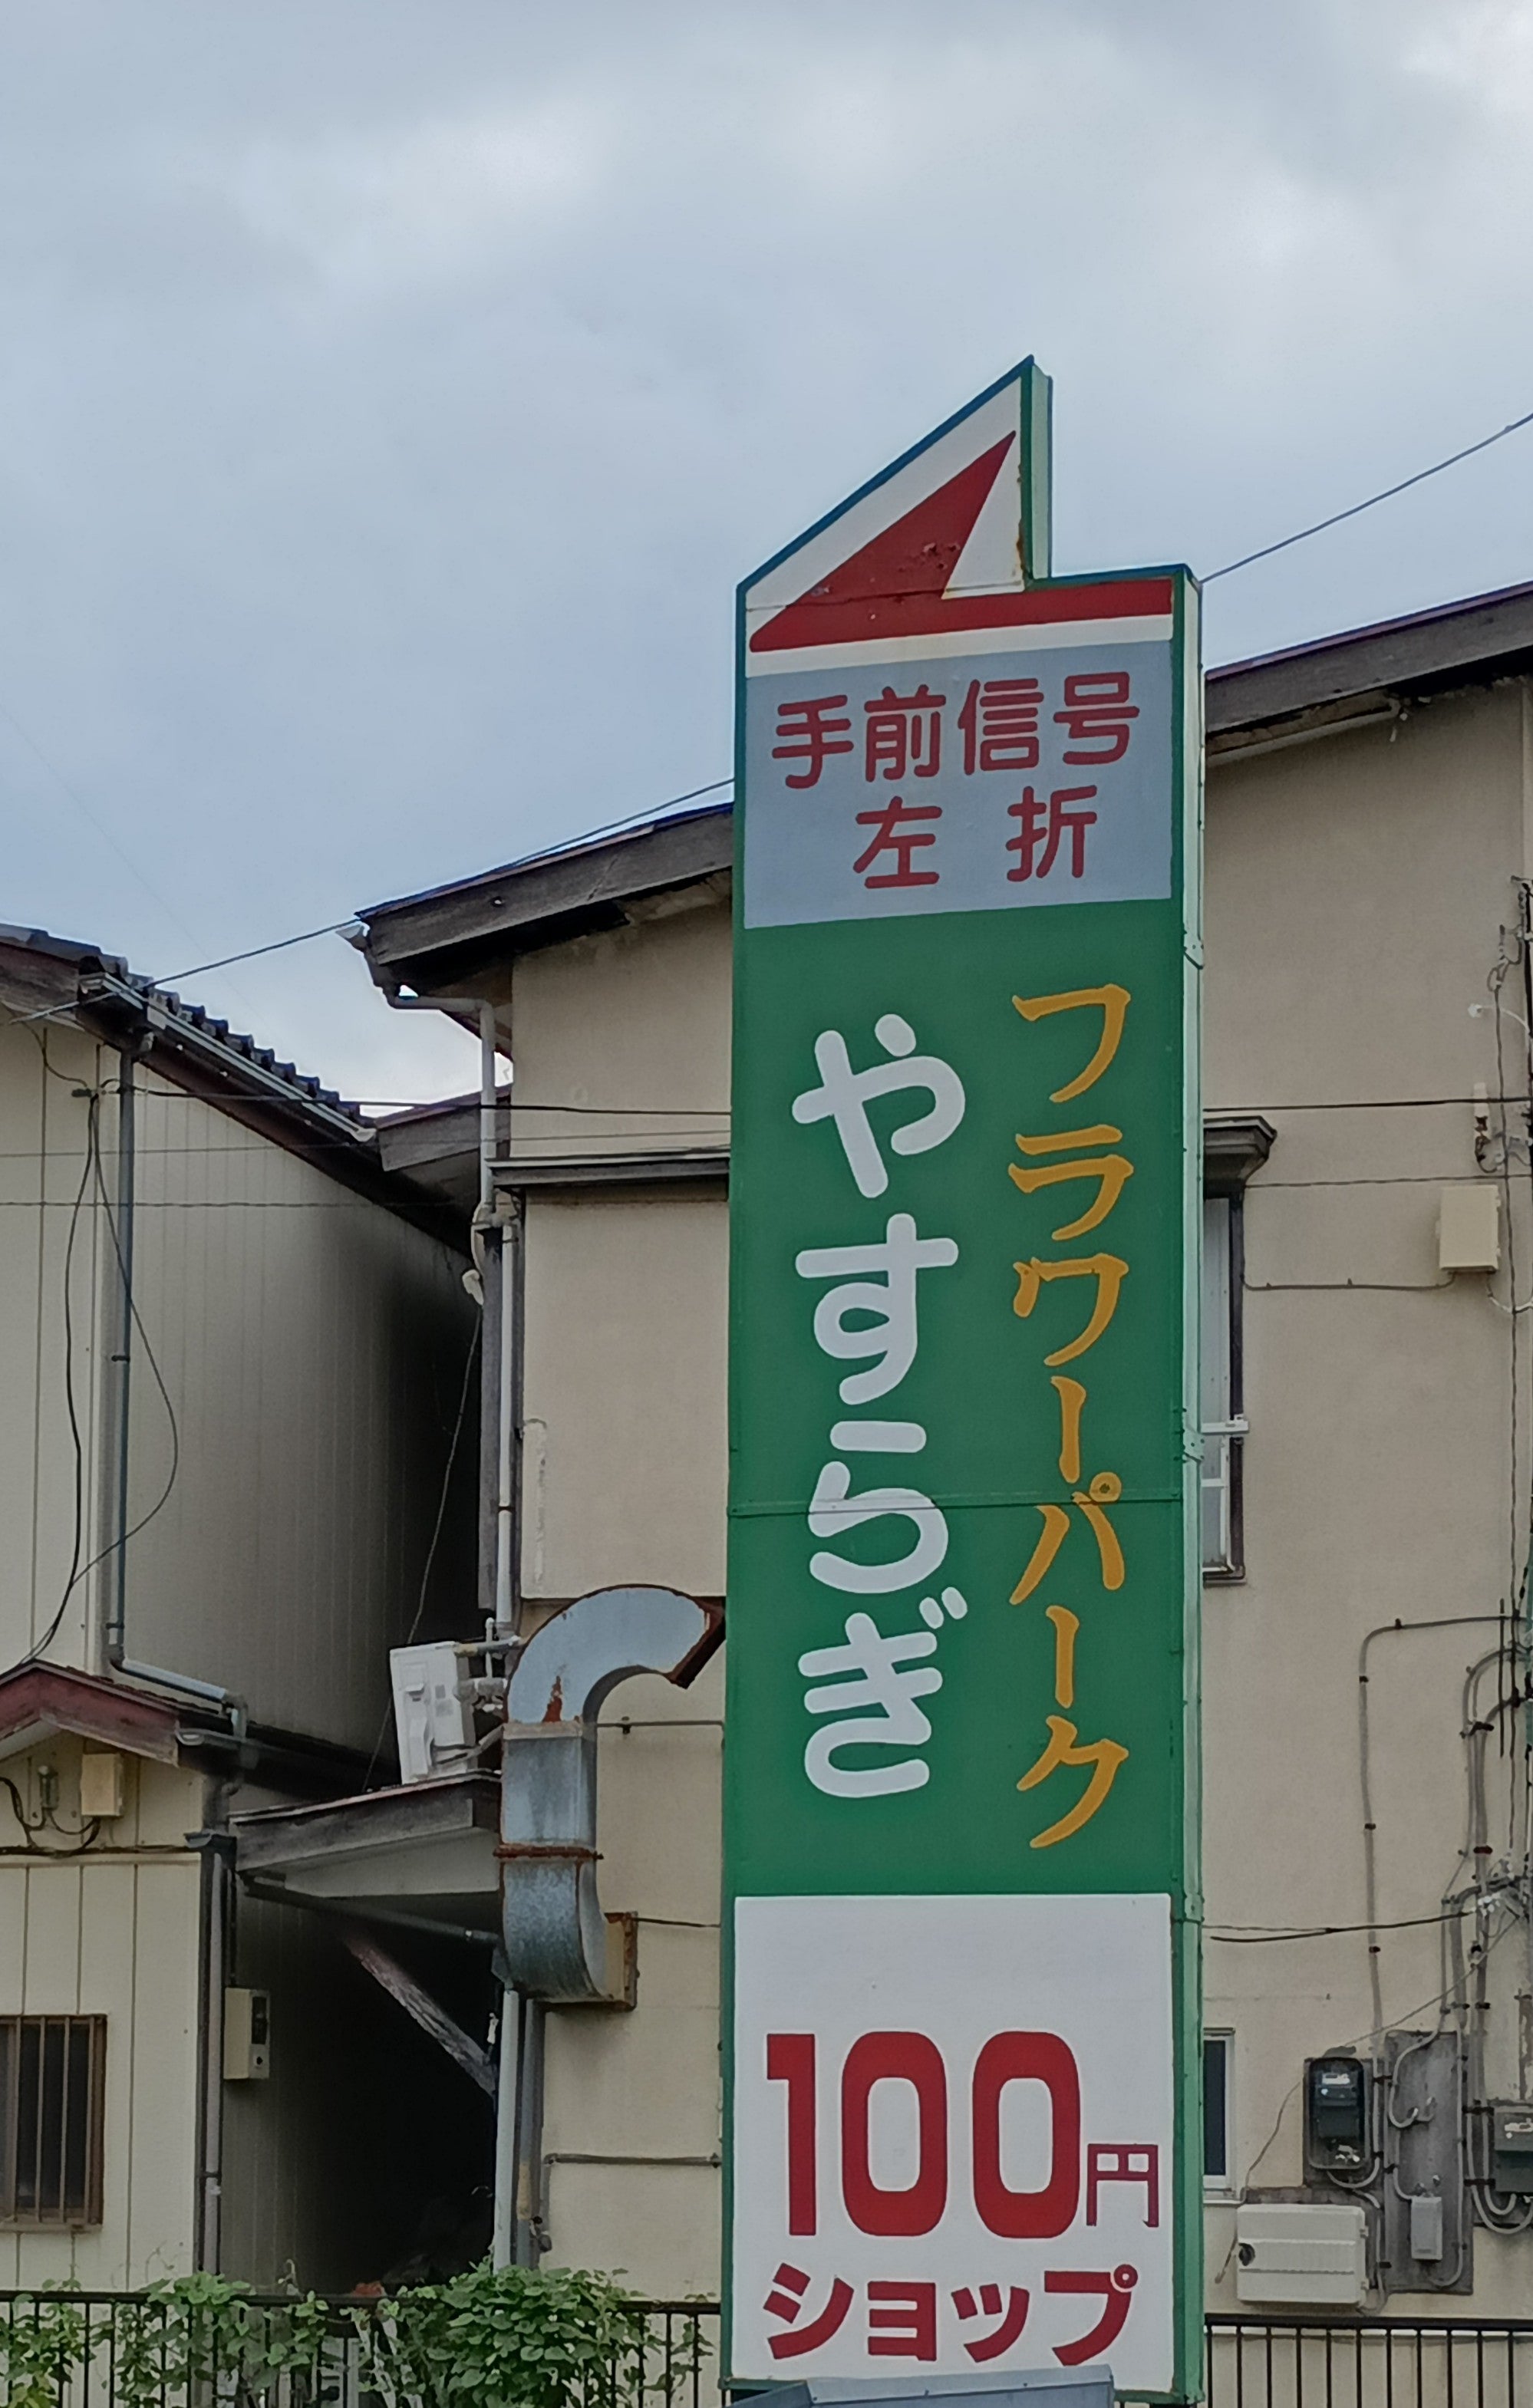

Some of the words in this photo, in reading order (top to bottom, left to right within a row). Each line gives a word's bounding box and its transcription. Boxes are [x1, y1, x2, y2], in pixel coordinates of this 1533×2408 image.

[772, 671, 1140, 789] 手前信号
[791, 1013, 968, 1800] やすらぎ
[1007, 983, 1134, 1849] フラワーパーク
[766, 2029, 1160, 2239] 100円
[763, 2262, 1139, 2367] ショップ
